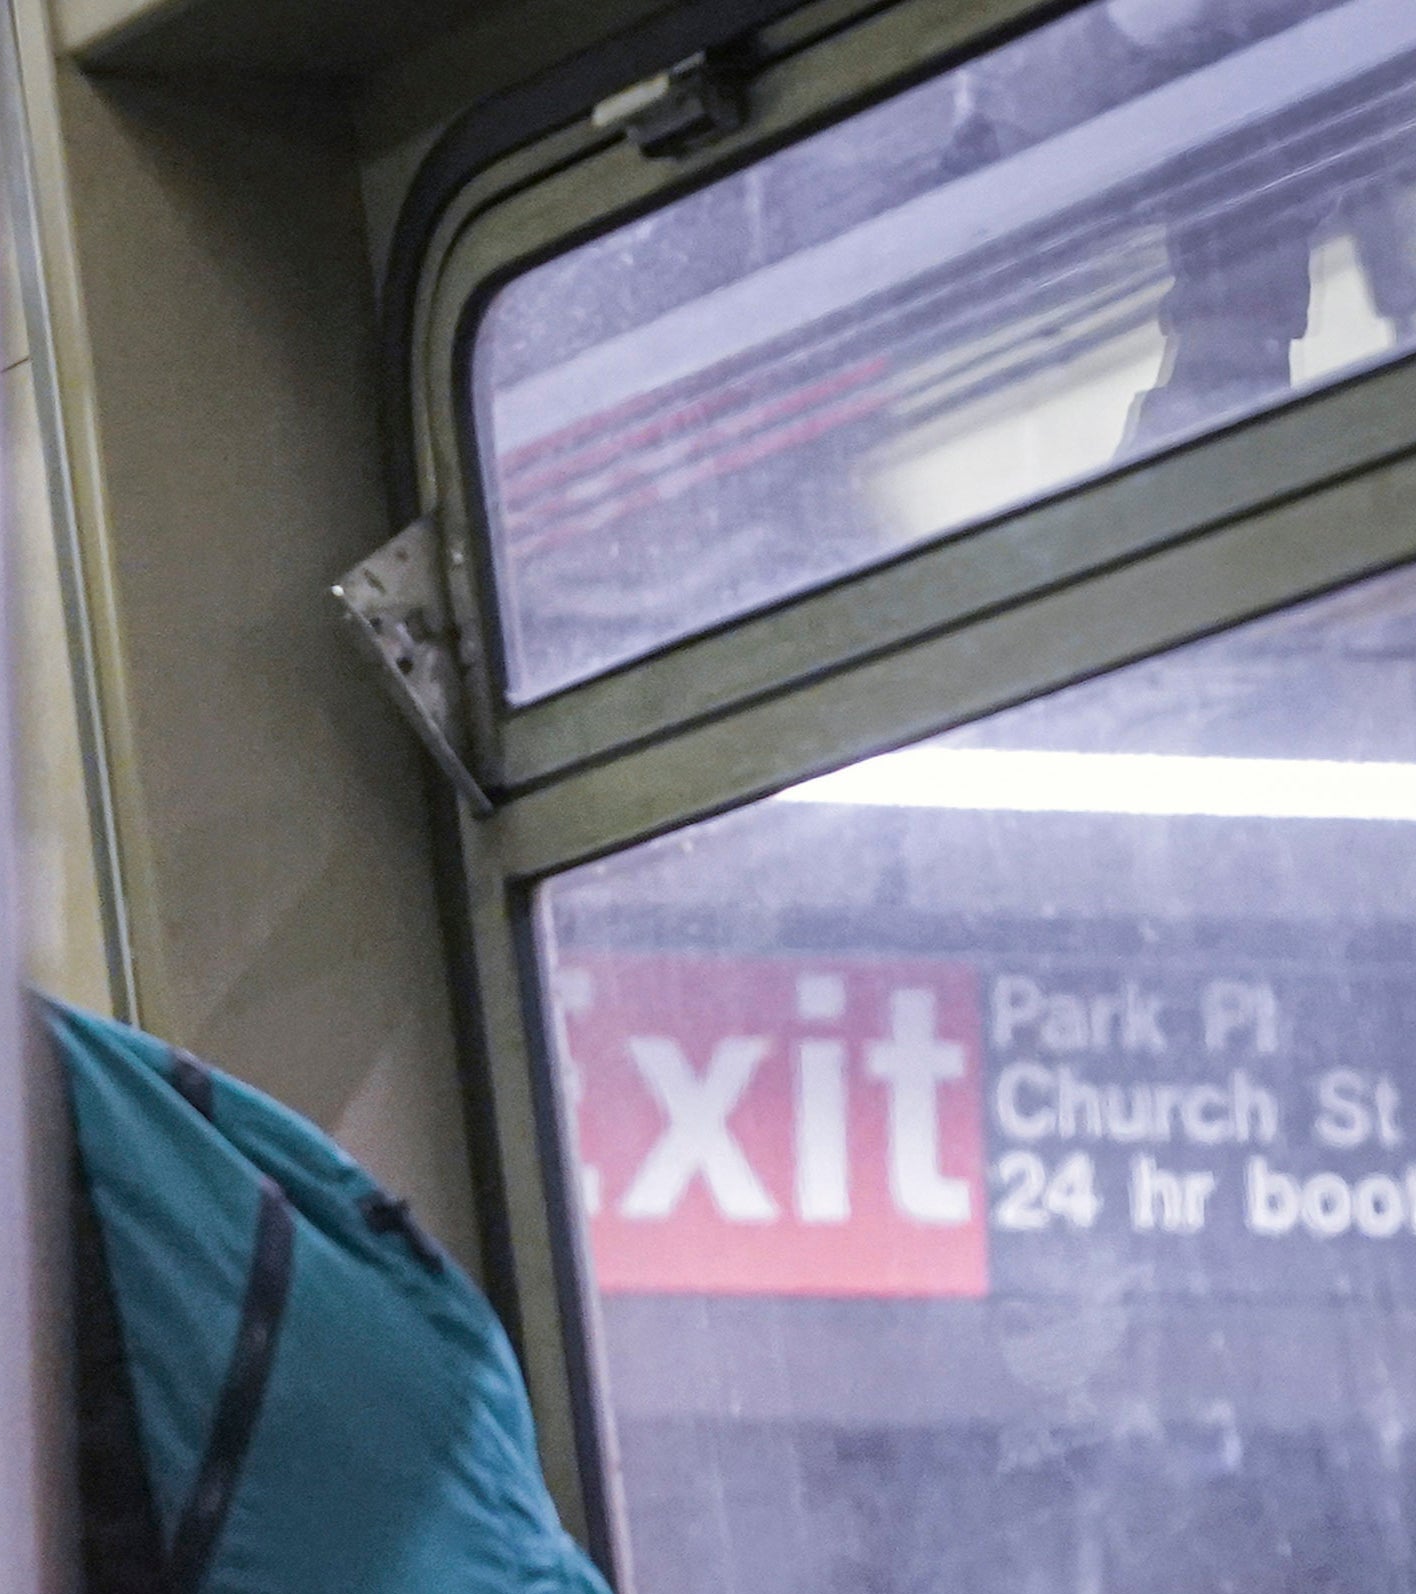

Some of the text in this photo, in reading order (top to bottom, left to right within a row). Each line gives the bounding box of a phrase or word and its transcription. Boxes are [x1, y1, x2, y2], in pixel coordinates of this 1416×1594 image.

[991, 975, 1279, 1053] Park Pl
[560, 967, 971, 1225] xit
[996, 1061, 1404, 1150] Church St
[992, 1151, 1104, 1232] 24
[1128, 1152, 1216, 1234] hr
